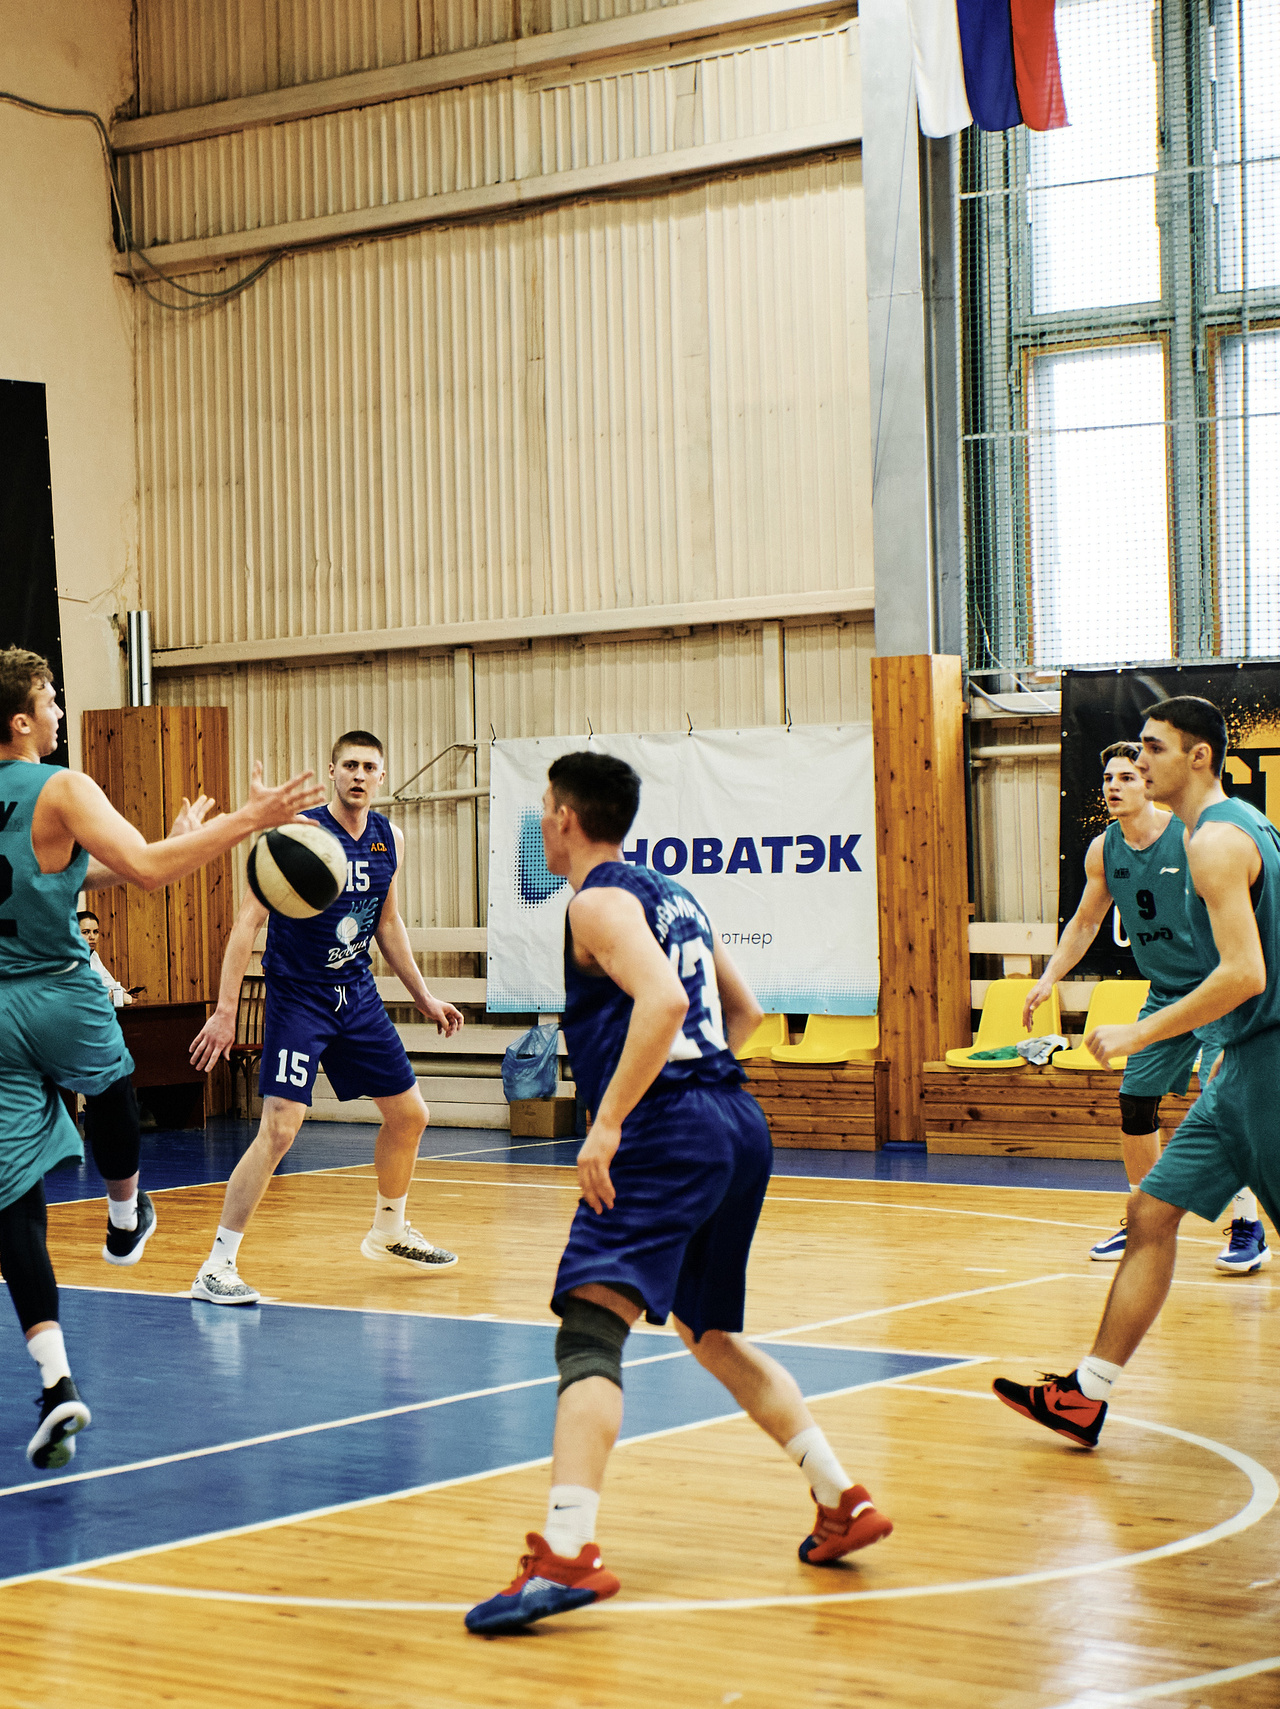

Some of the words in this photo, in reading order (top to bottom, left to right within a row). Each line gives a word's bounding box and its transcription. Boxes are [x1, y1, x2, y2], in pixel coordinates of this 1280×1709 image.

[622, 833, 863, 876] НОВАТЭК
[346, 860, 371, 892] 15
[1136, 889, 1157, 920] 9
[275, 1048, 310, 1088] 15
